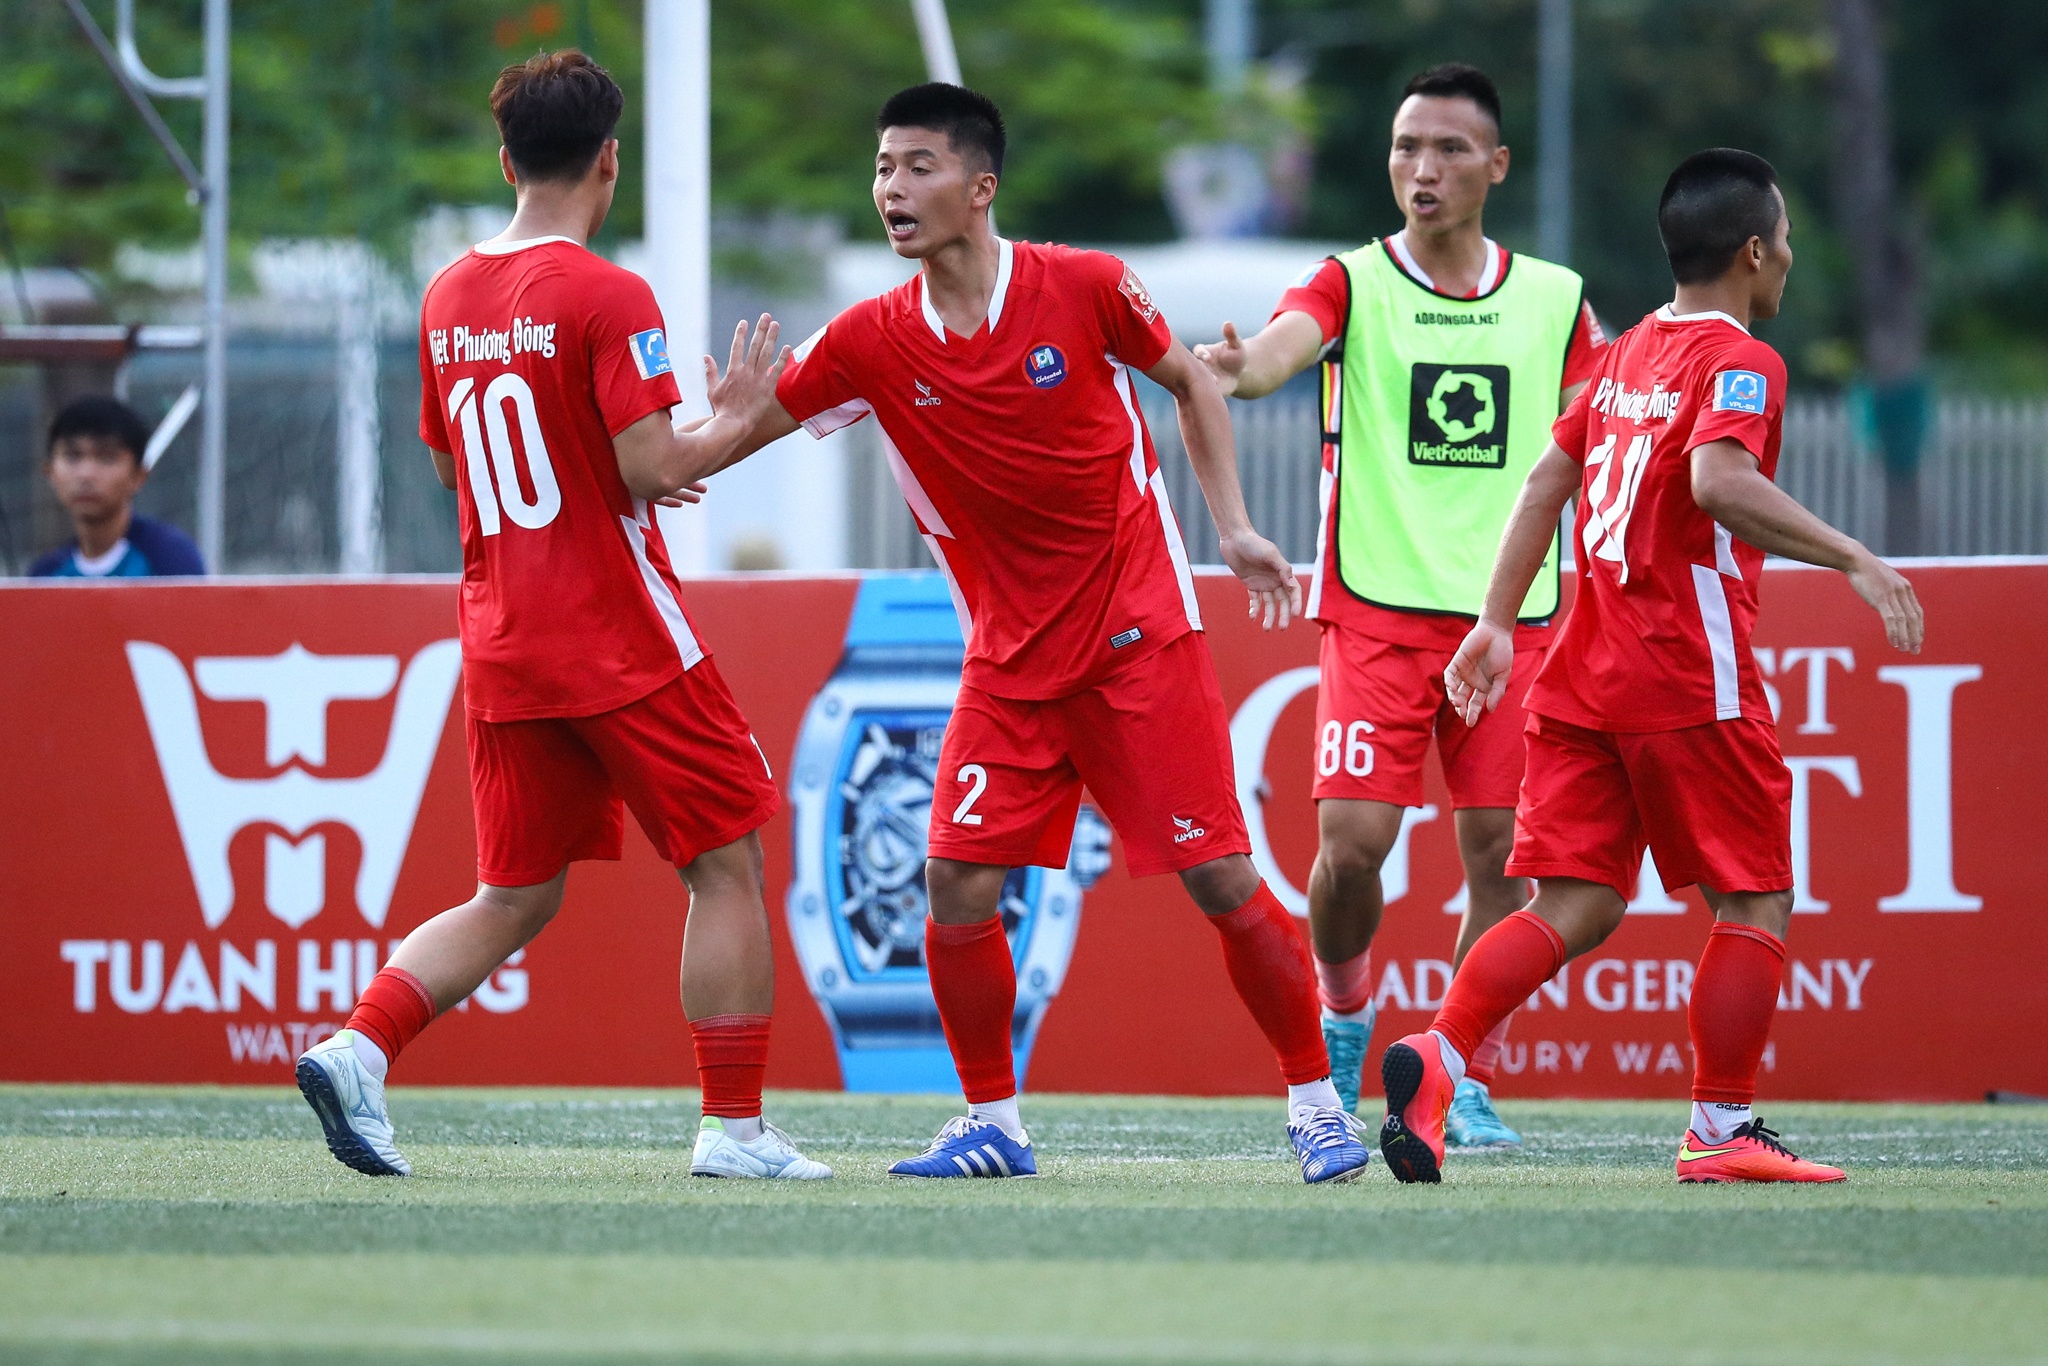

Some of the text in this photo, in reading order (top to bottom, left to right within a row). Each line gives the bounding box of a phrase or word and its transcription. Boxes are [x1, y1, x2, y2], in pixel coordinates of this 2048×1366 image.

[453, 325, 511, 365] Phương
[513, 316, 556, 358] Đông
[915, 397, 942, 407] KAMITO
[447, 372, 562, 537] 10
[1412, 442, 1499, 464] VietFootball
[1318, 719, 1376, 777] 86
[952, 763, 988, 826] 2
[1174, 827, 1205, 844] KAMITO
[60, 939, 529, 1013] TUAN HG
[1582, 957, 1874, 1012] GERNY
